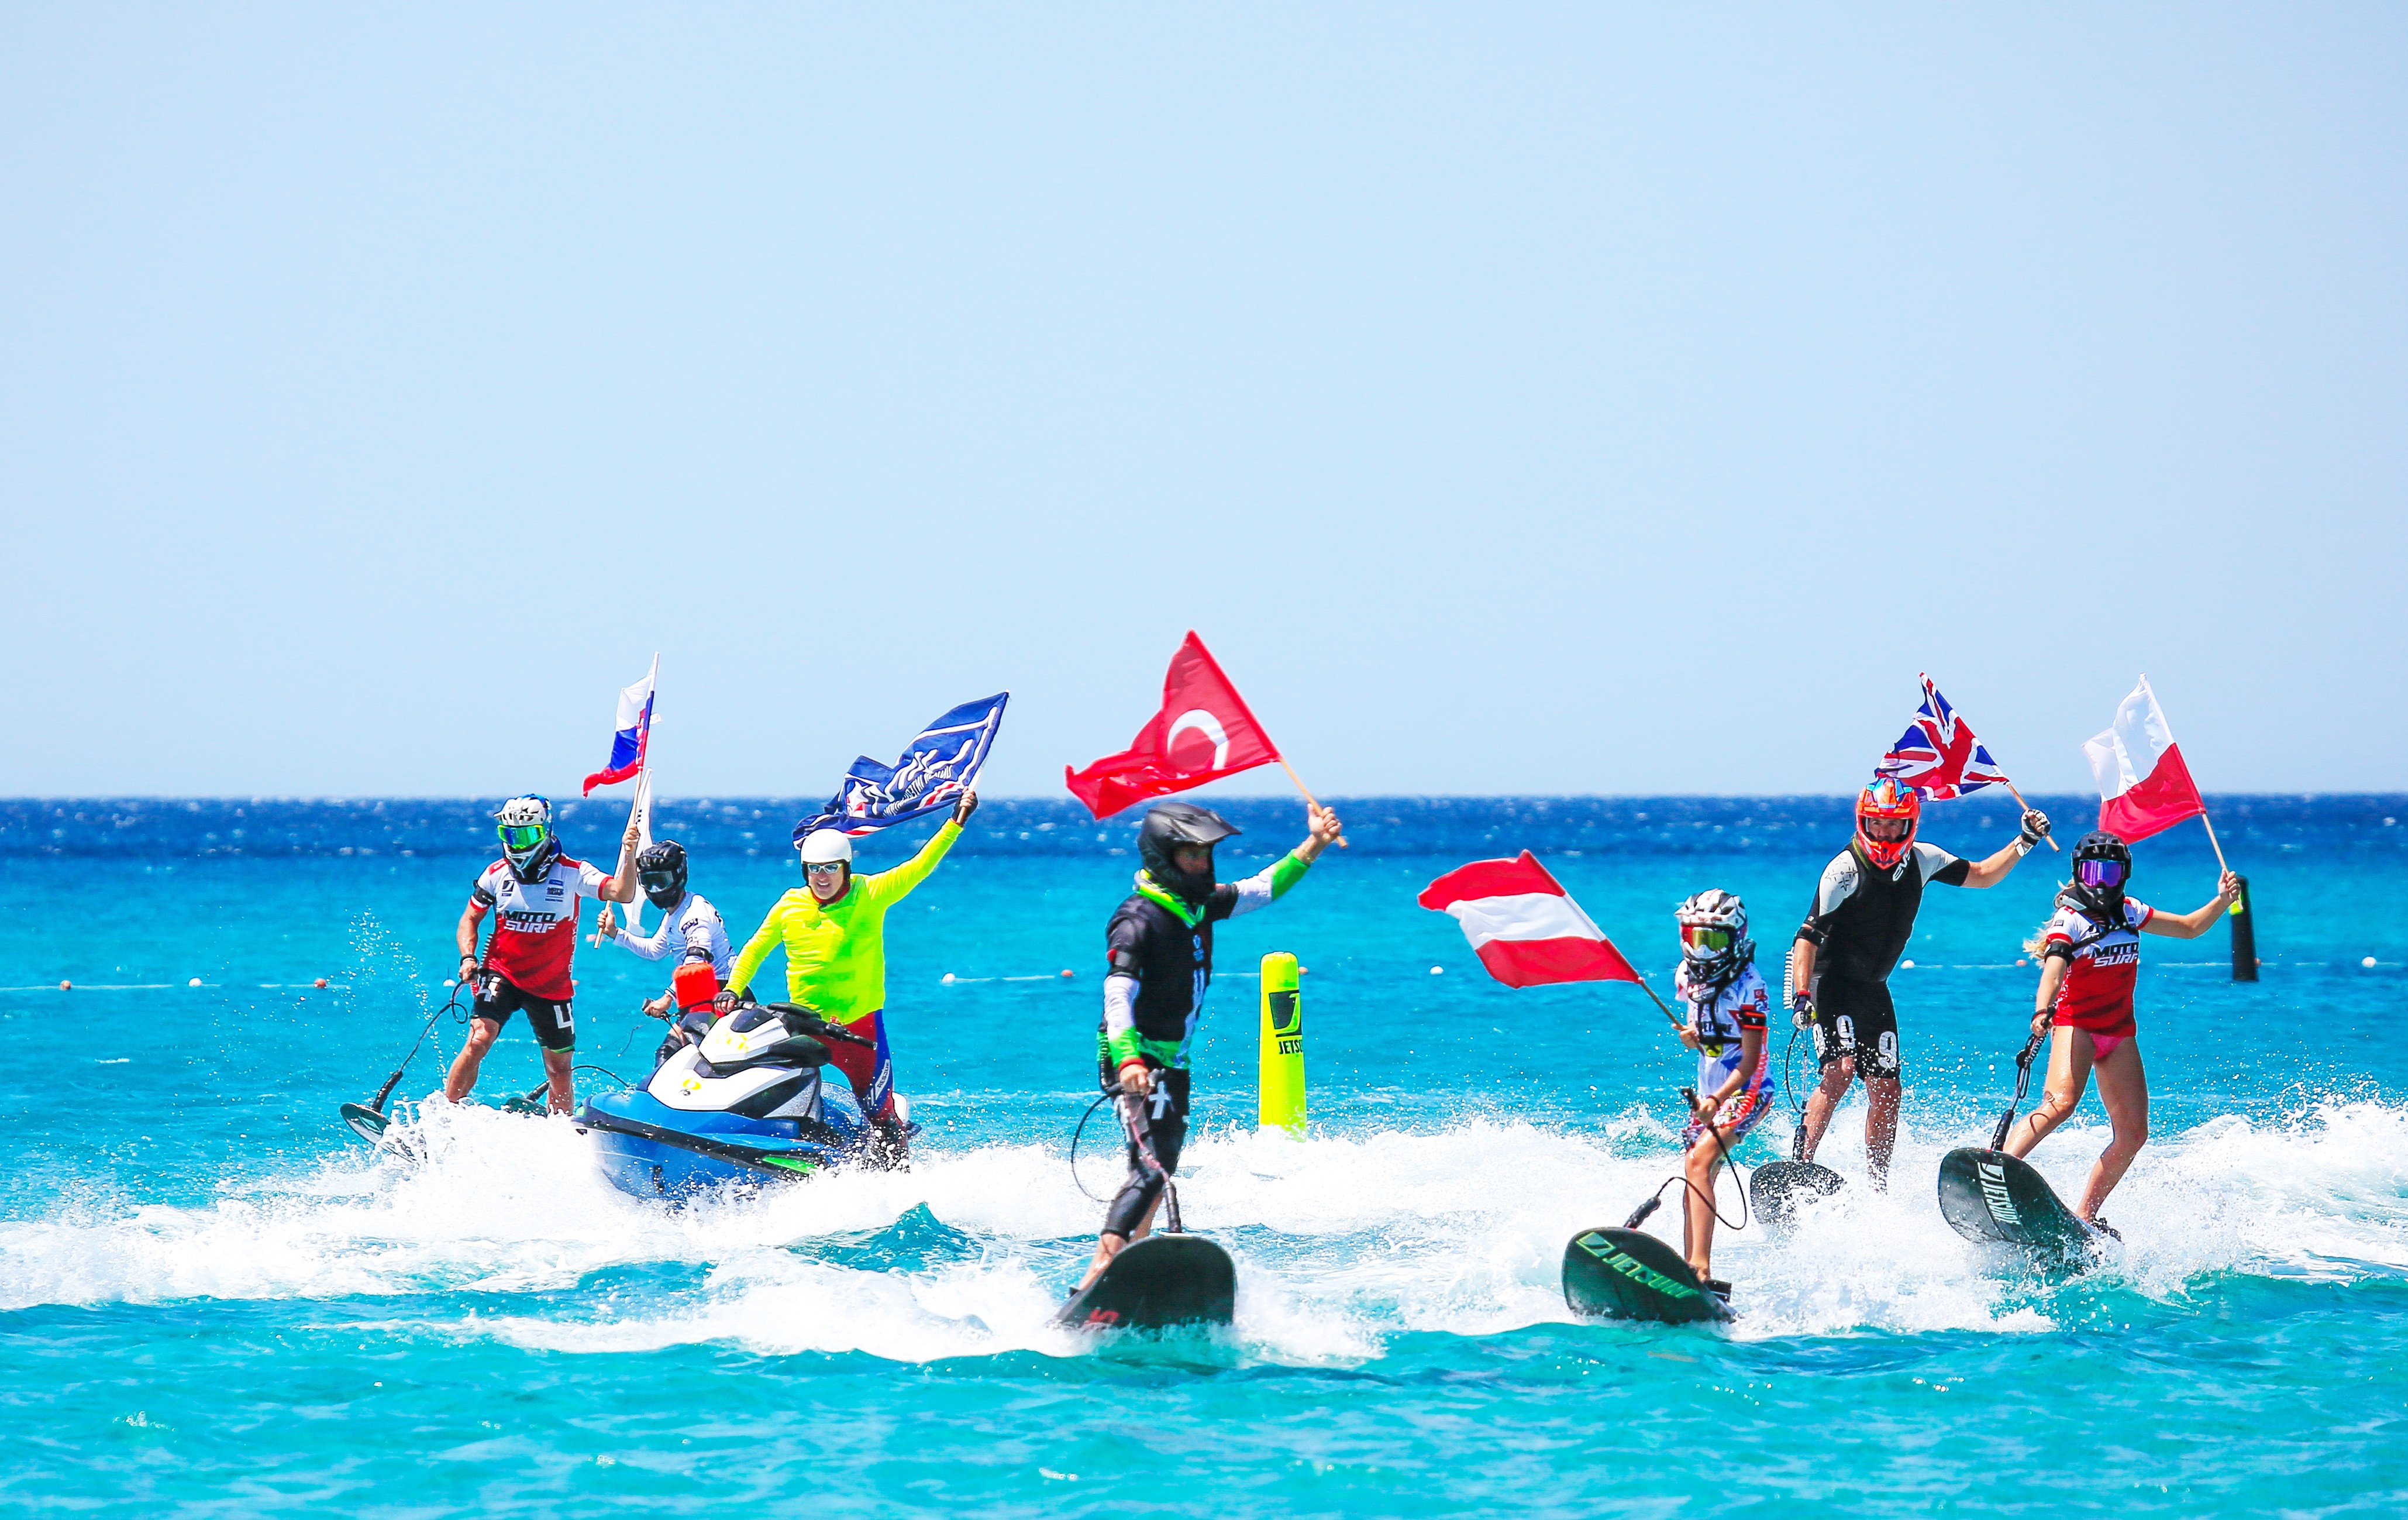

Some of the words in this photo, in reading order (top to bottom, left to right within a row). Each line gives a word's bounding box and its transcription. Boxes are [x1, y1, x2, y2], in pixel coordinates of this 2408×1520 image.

[504, 910, 556, 923] MOTO
[504, 920, 556, 933] SURF
[2087, 942, 2139, 959] MOTO
[2093, 953, 2138, 967] SURF
[553, 1002, 574, 1035] 4
[1878, 1031, 1897, 1068] 9
